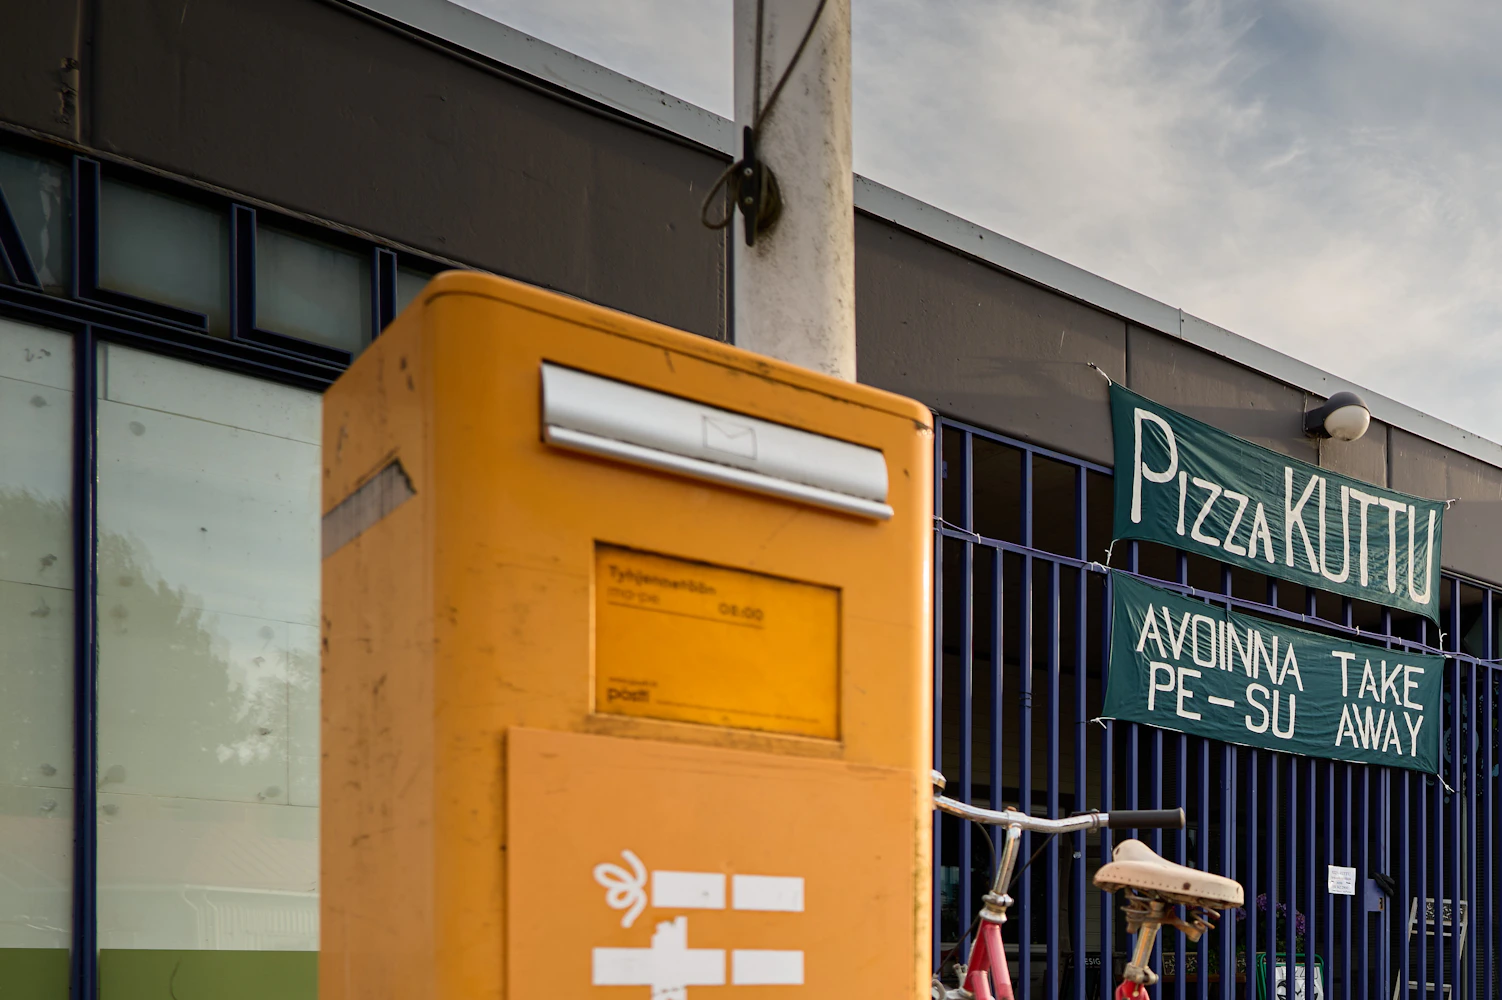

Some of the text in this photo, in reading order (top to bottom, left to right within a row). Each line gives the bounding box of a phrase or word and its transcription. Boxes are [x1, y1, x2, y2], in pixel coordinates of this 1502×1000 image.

[1285, 467, 1436, 605] KUTTU
[1136, 603, 1304, 692] AVOINNA
[1332, 651, 1425, 711] TAKE
[1335, 704, 1424, 758] AWAY
